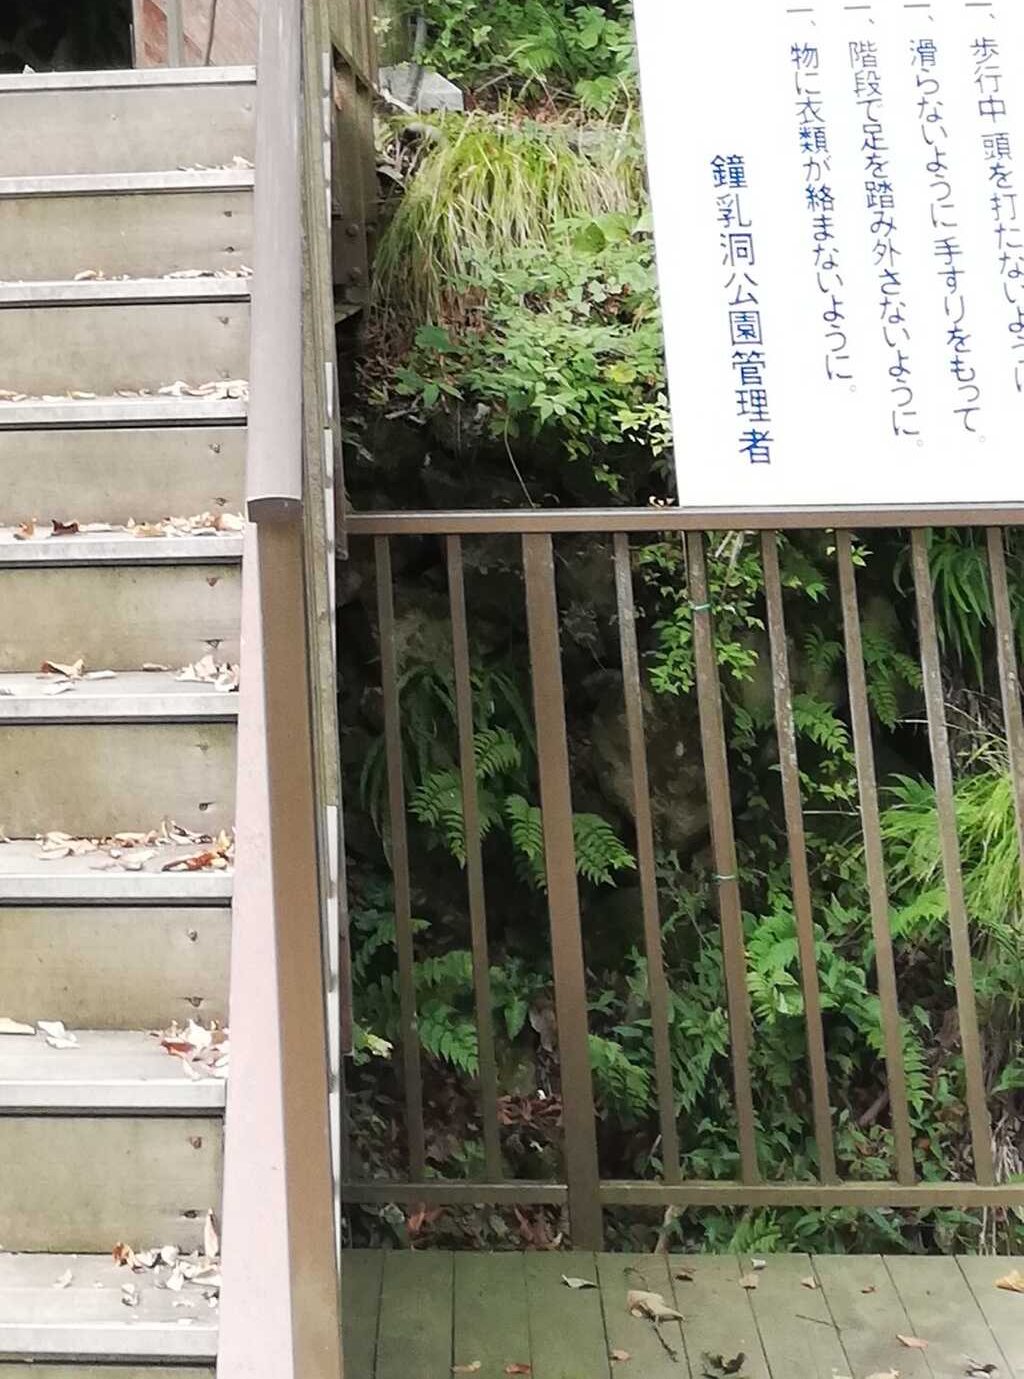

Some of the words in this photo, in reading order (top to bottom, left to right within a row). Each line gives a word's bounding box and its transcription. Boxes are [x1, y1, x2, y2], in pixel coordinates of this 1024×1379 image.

[710, 154, 774, 464] 鐘乳洞公園管理者
